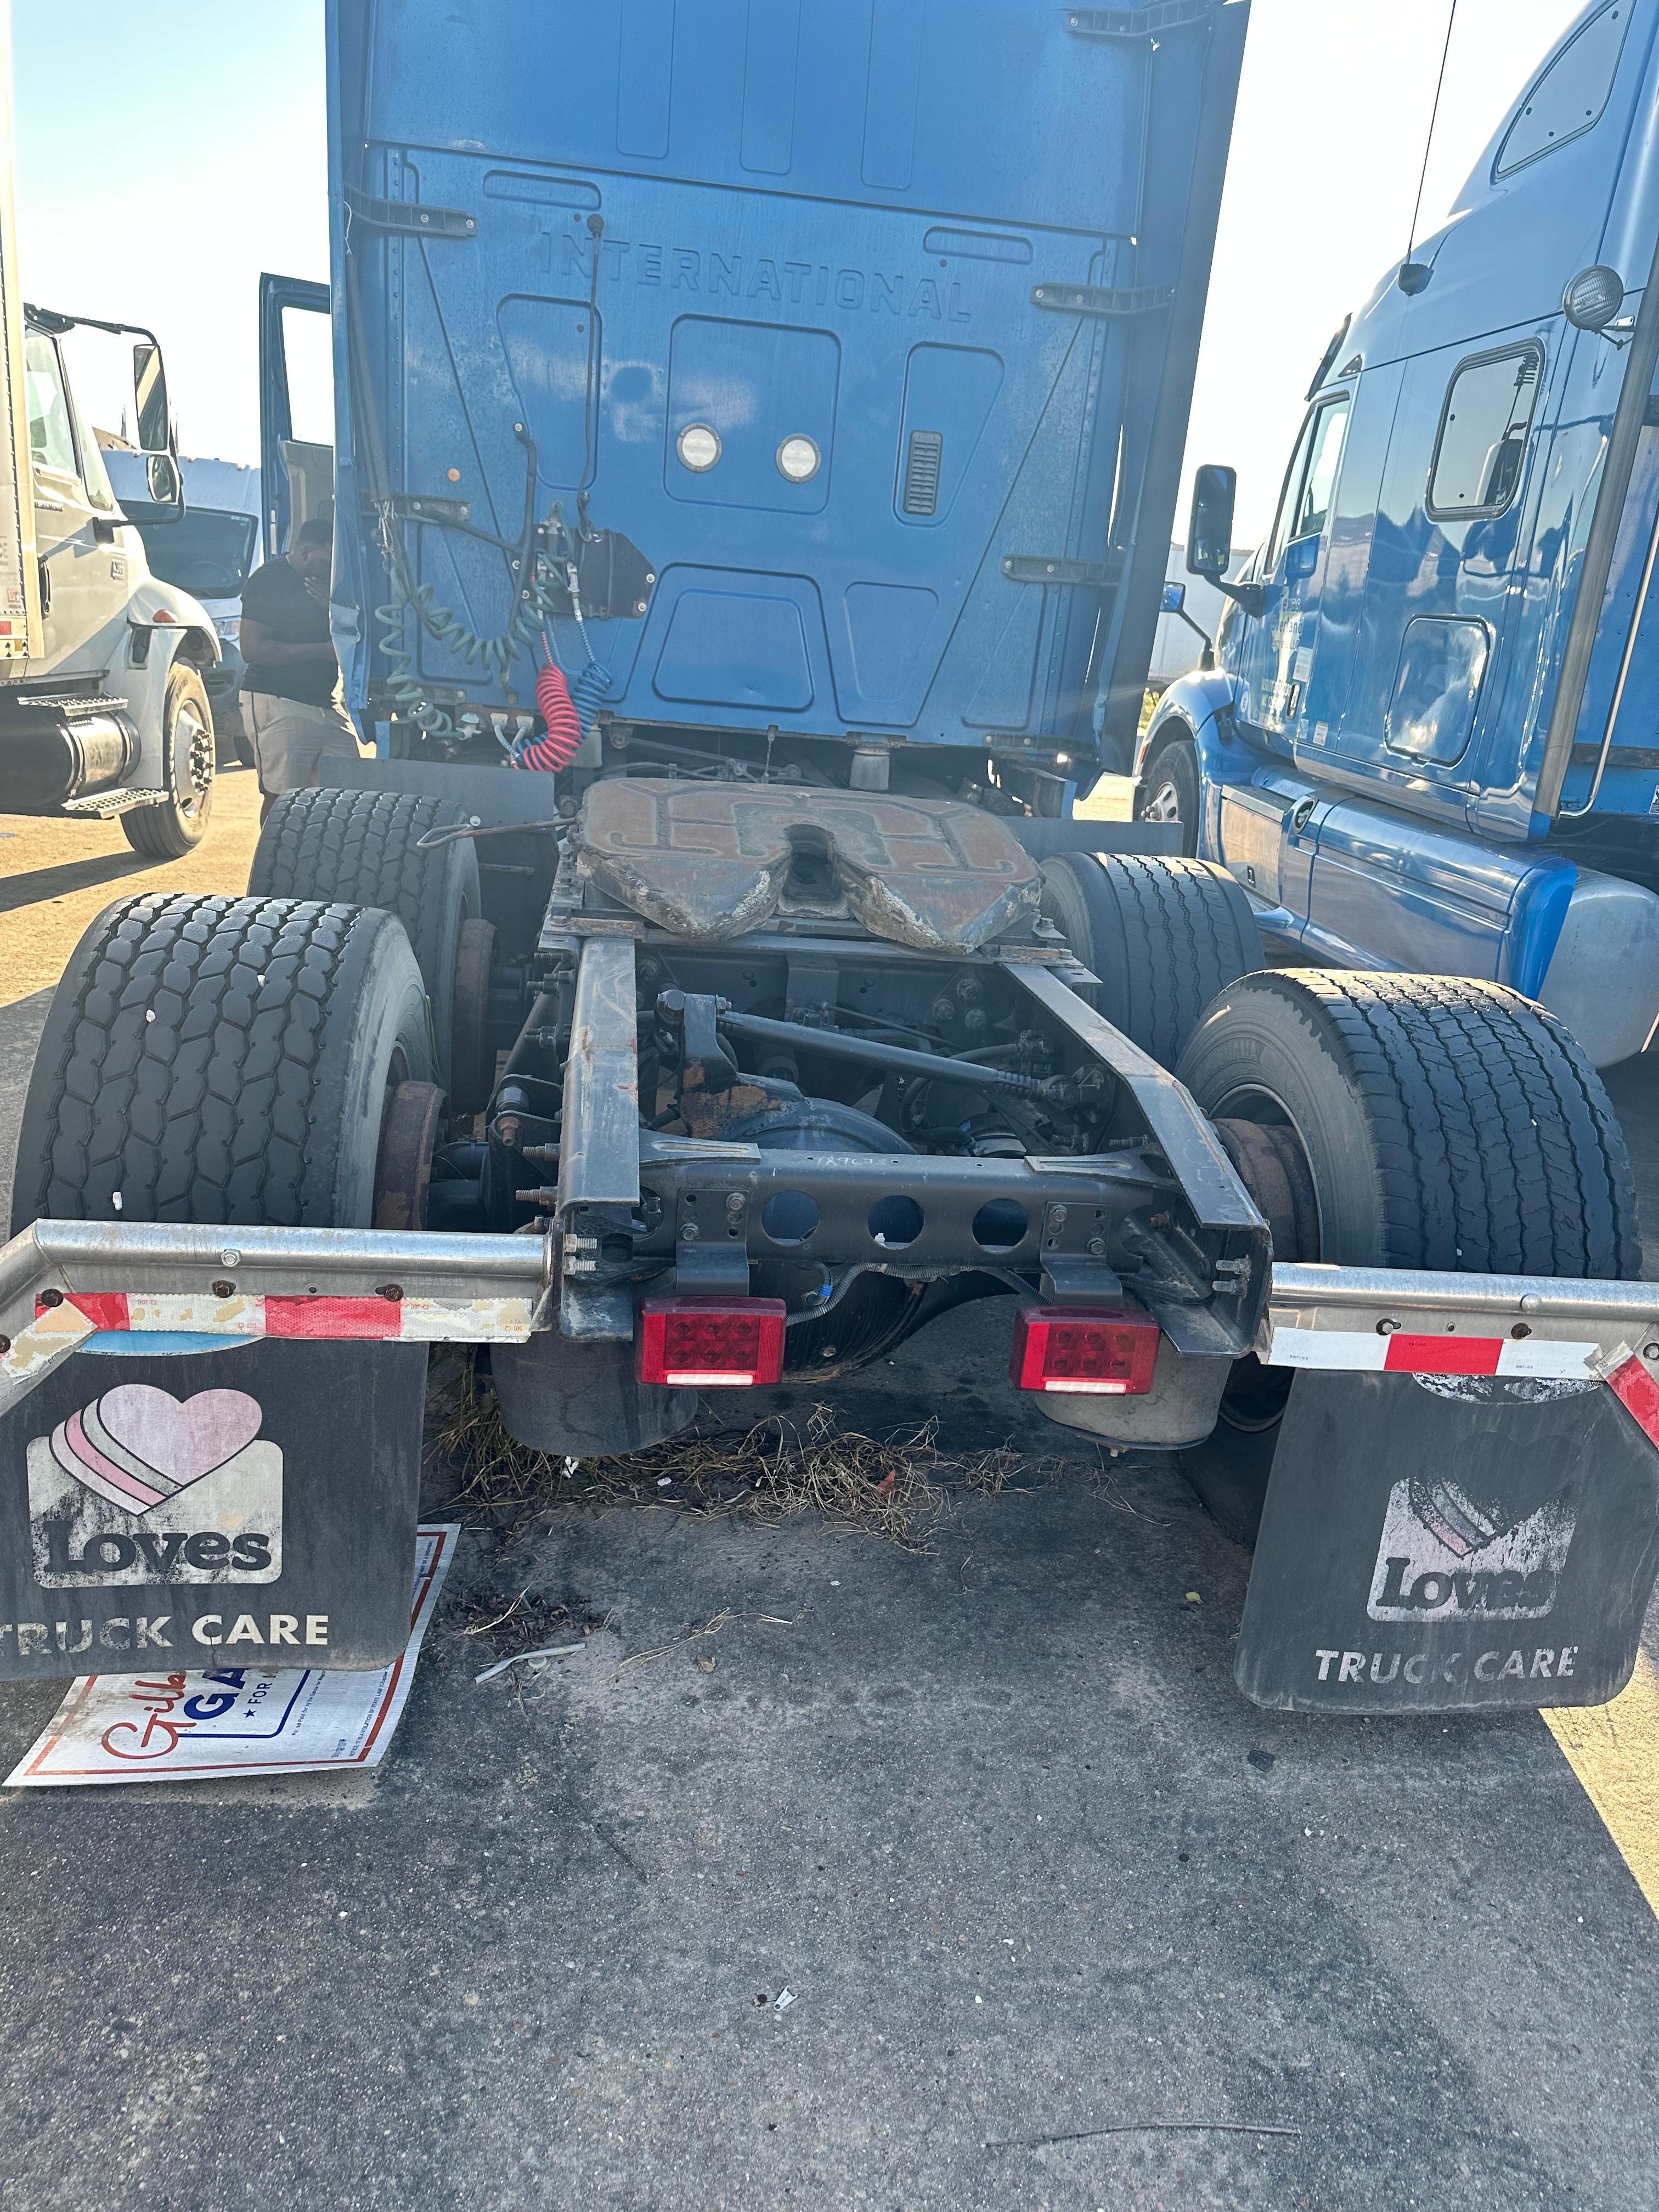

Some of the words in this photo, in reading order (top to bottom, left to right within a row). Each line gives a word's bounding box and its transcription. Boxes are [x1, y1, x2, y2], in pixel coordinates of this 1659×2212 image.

[540, 232, 971, 324] INTERNATIONAL
[1271, 615, 1304, 635] Overland
[43, 1521, 271, 1574] Loves
[1375, 1557, 1555, 1610] Loves
[191, 1615, 329, 1645] CARE
[1316, 1647, 1462, 1684] TRUCK
[1474, 1646, 1578, 1681] CARE
[101, 1673, 196, 1759] Gilb
[184, 1668, 251, 1720] GA
[247, 1683, 273, 1704] FOR
[360, 1714, 373, 1733] VIOLATION
[371, 1697, 380, 1708] STATE
